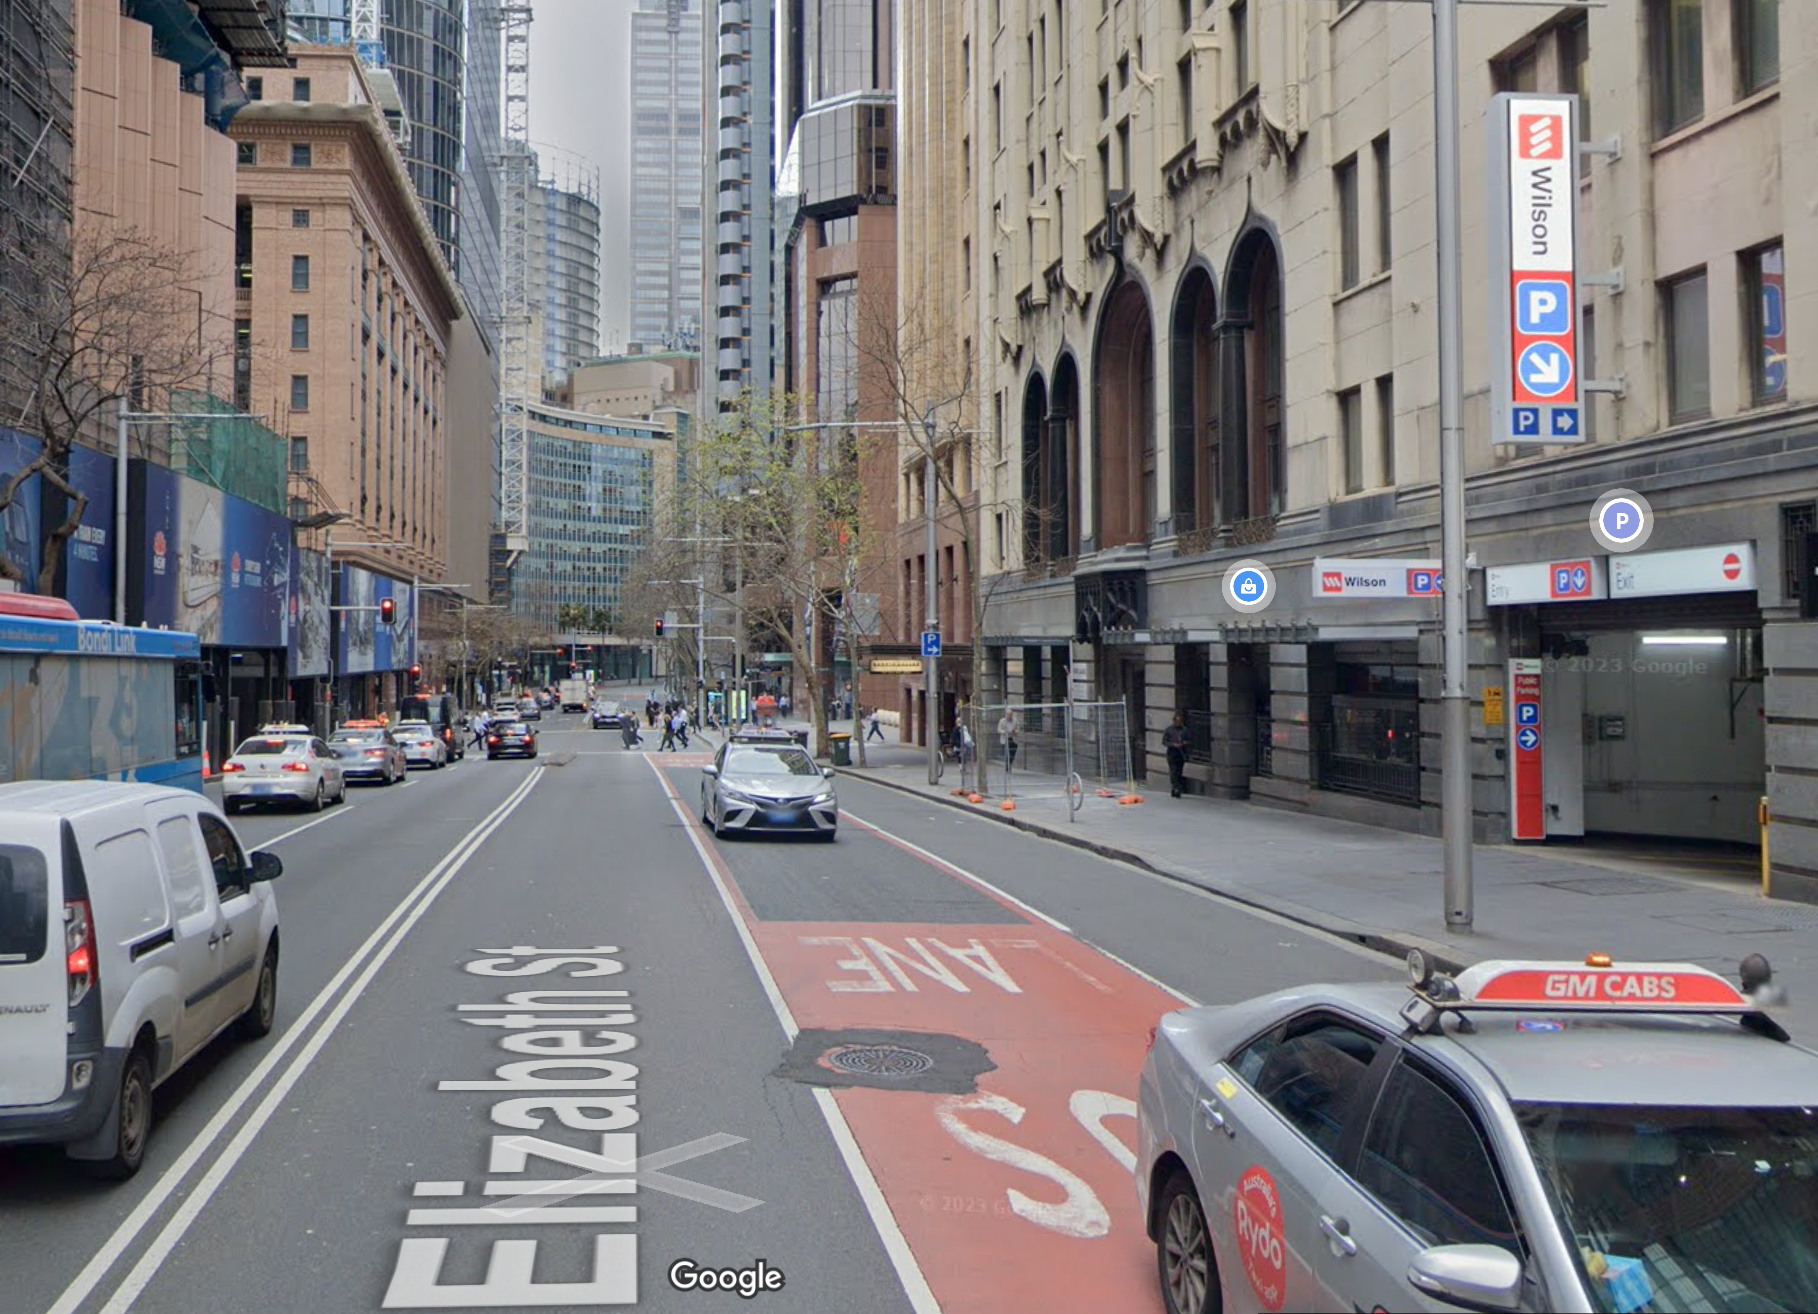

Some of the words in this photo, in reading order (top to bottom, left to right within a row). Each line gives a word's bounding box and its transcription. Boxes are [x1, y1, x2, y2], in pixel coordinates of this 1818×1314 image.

[1531, 165, 1553, 256] Wilson
[1529, 290, 1557, 324] P
[1518, 411, 1535, 432] P
[1344, 577, 1387, 587] Wilson
[1417, 575, 1429, 588] P
[1560, 573, 1568, 588] P
[77, 627, 112, 652] Bondi
[114, 629, 137, 653] Link
[927, 633, 937, 644] P
[1522, 706, 1534, 721] P
[1545, 974, 1597, 998] GM
[1603, 975, 1676, 998] CABS
[1238, 1199, 1282, 1270] Rydo
